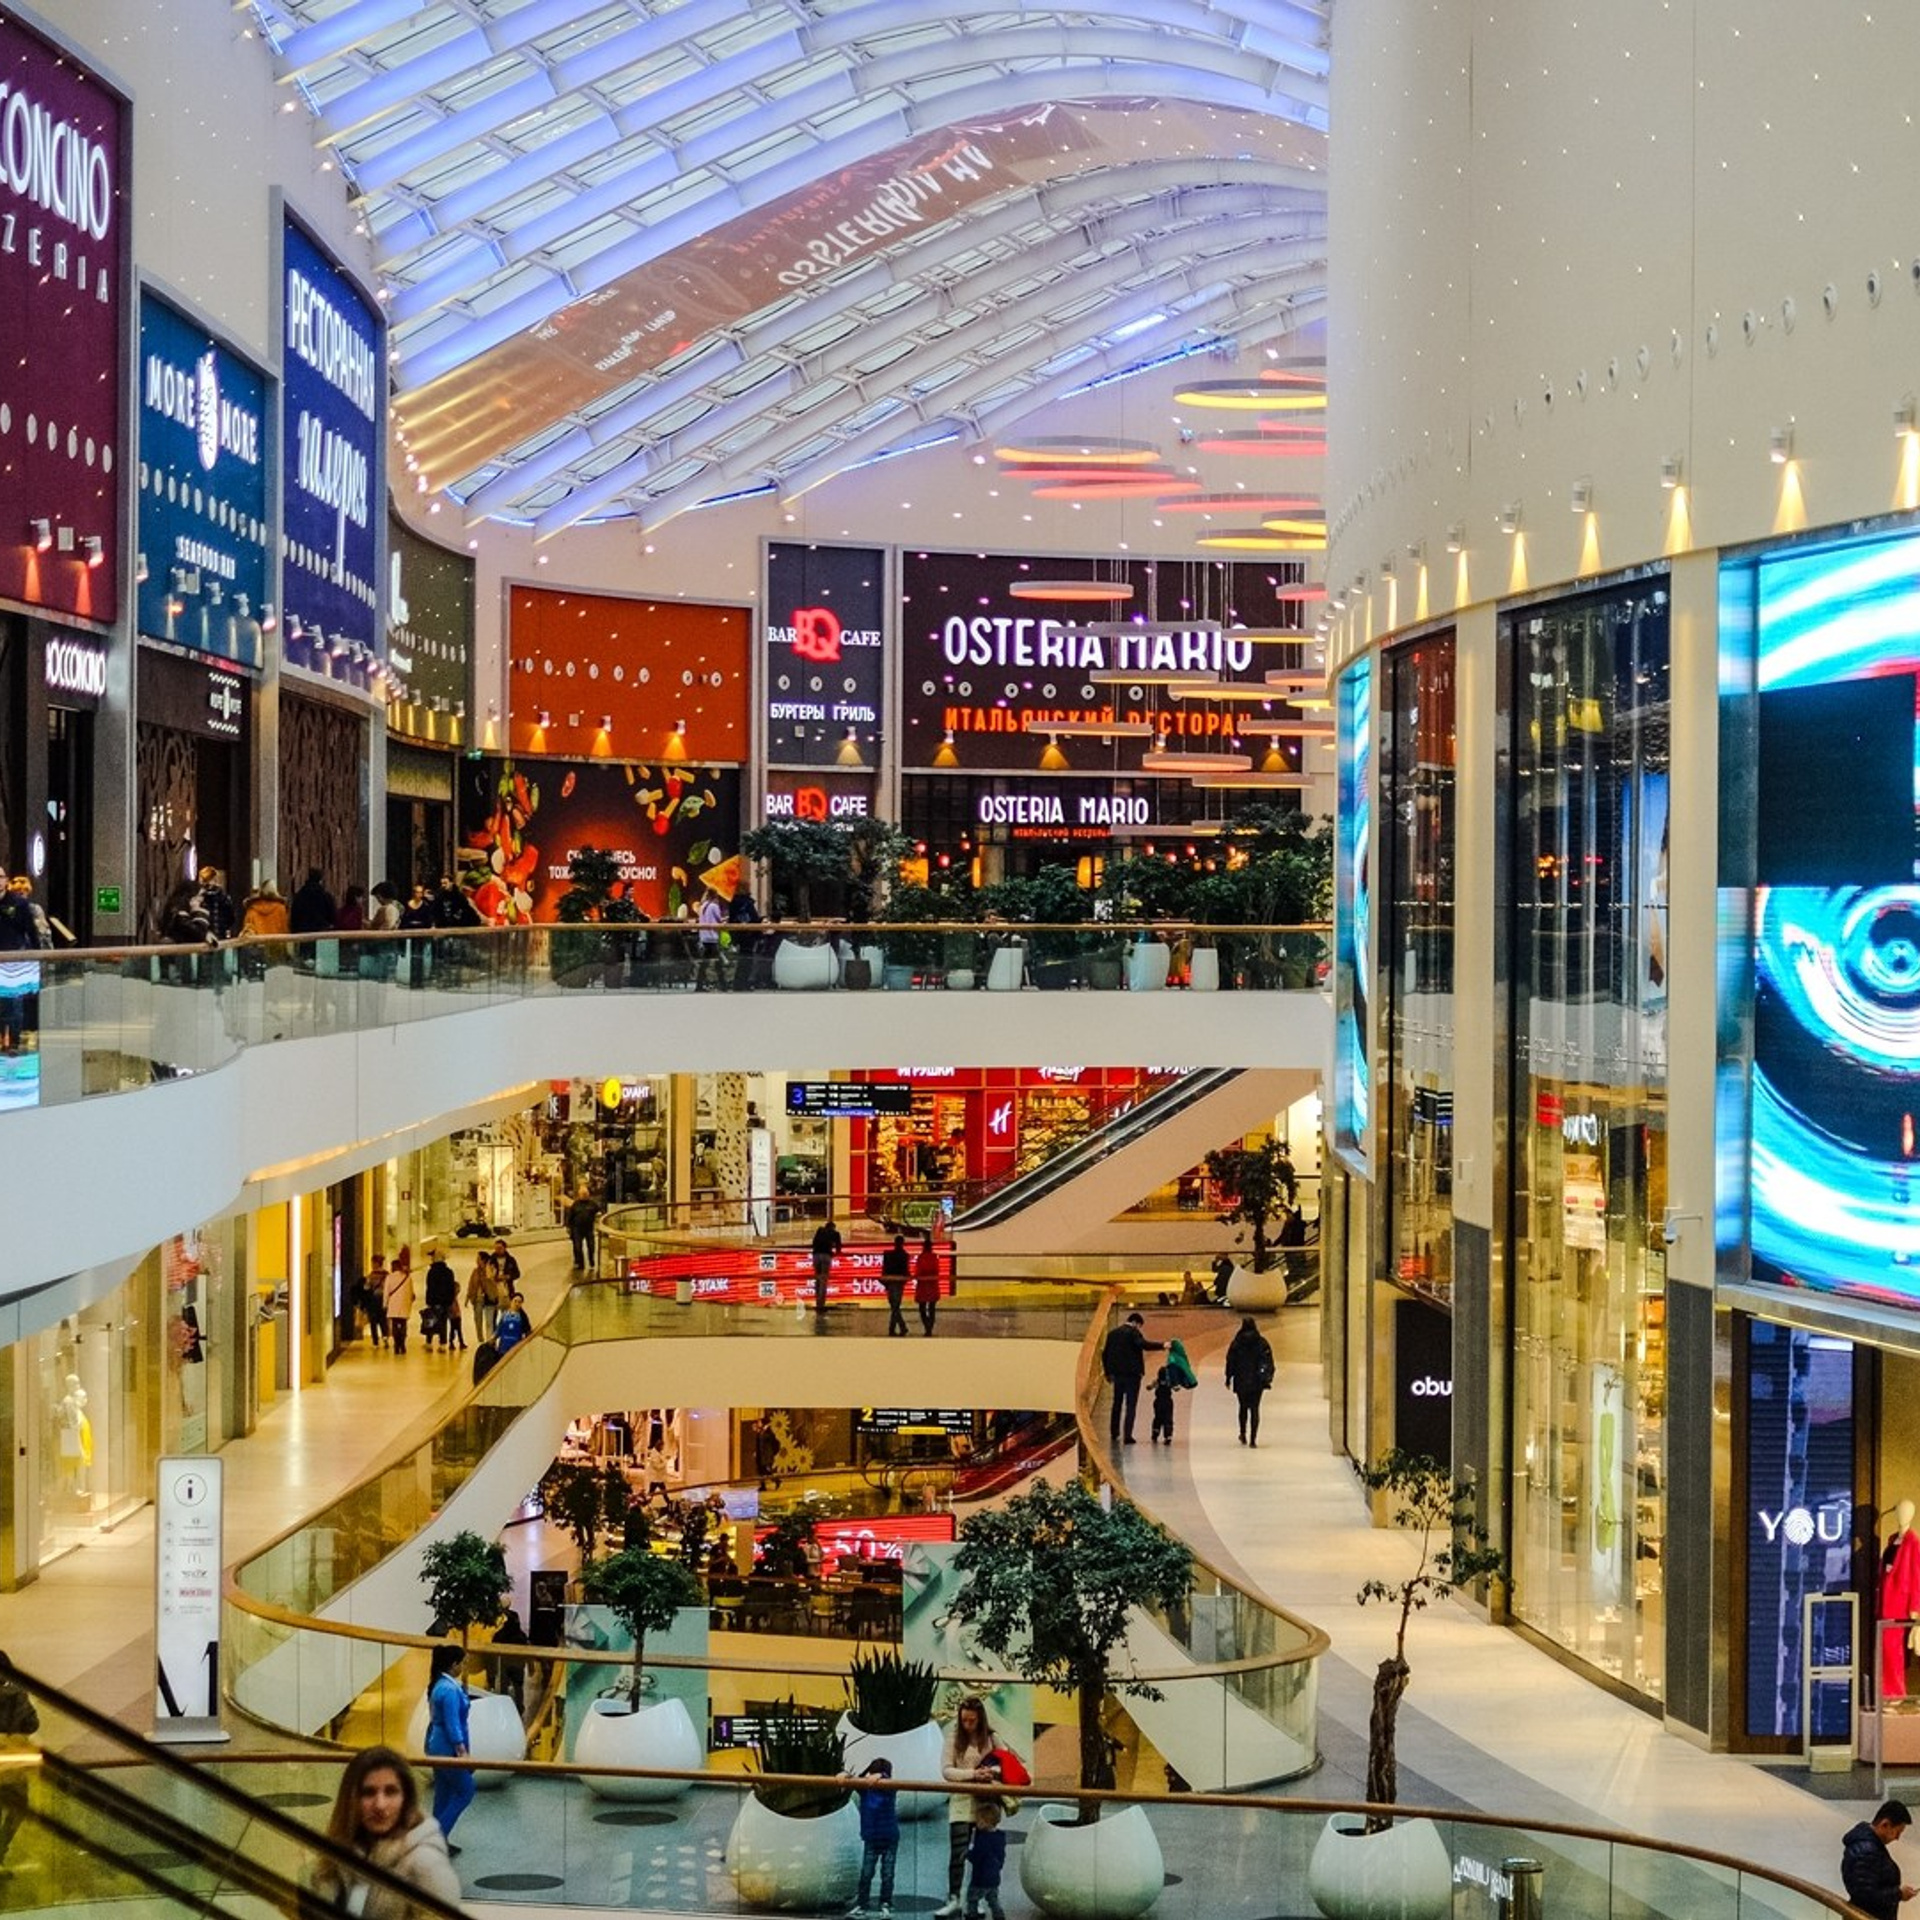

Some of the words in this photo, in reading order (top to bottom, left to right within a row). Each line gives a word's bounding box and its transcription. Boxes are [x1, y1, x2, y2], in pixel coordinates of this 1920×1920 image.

[0, 82, 109, 241] ONCINO
[768, 626, 797, 643] BAR
[840, 630, 882, 647] CAFE
[944, 615, 1105, 669] OSTERIA
[770, 702, 824, 720] БУРГЕРЫ
[833, 703, 876, 722] ГРИЛЬ
[766, 794, 794, 815] BAR
[830, 796, 867, 816] CAFE
[980, 796, 1064, 824] OSTERIA
[1080, 798, 1149, 825] MARIO
[792, 1087, 803, 1104] 3
[1411, 1375, 1453, 1396] obu
[862, 1407, 873, 1423] 2
